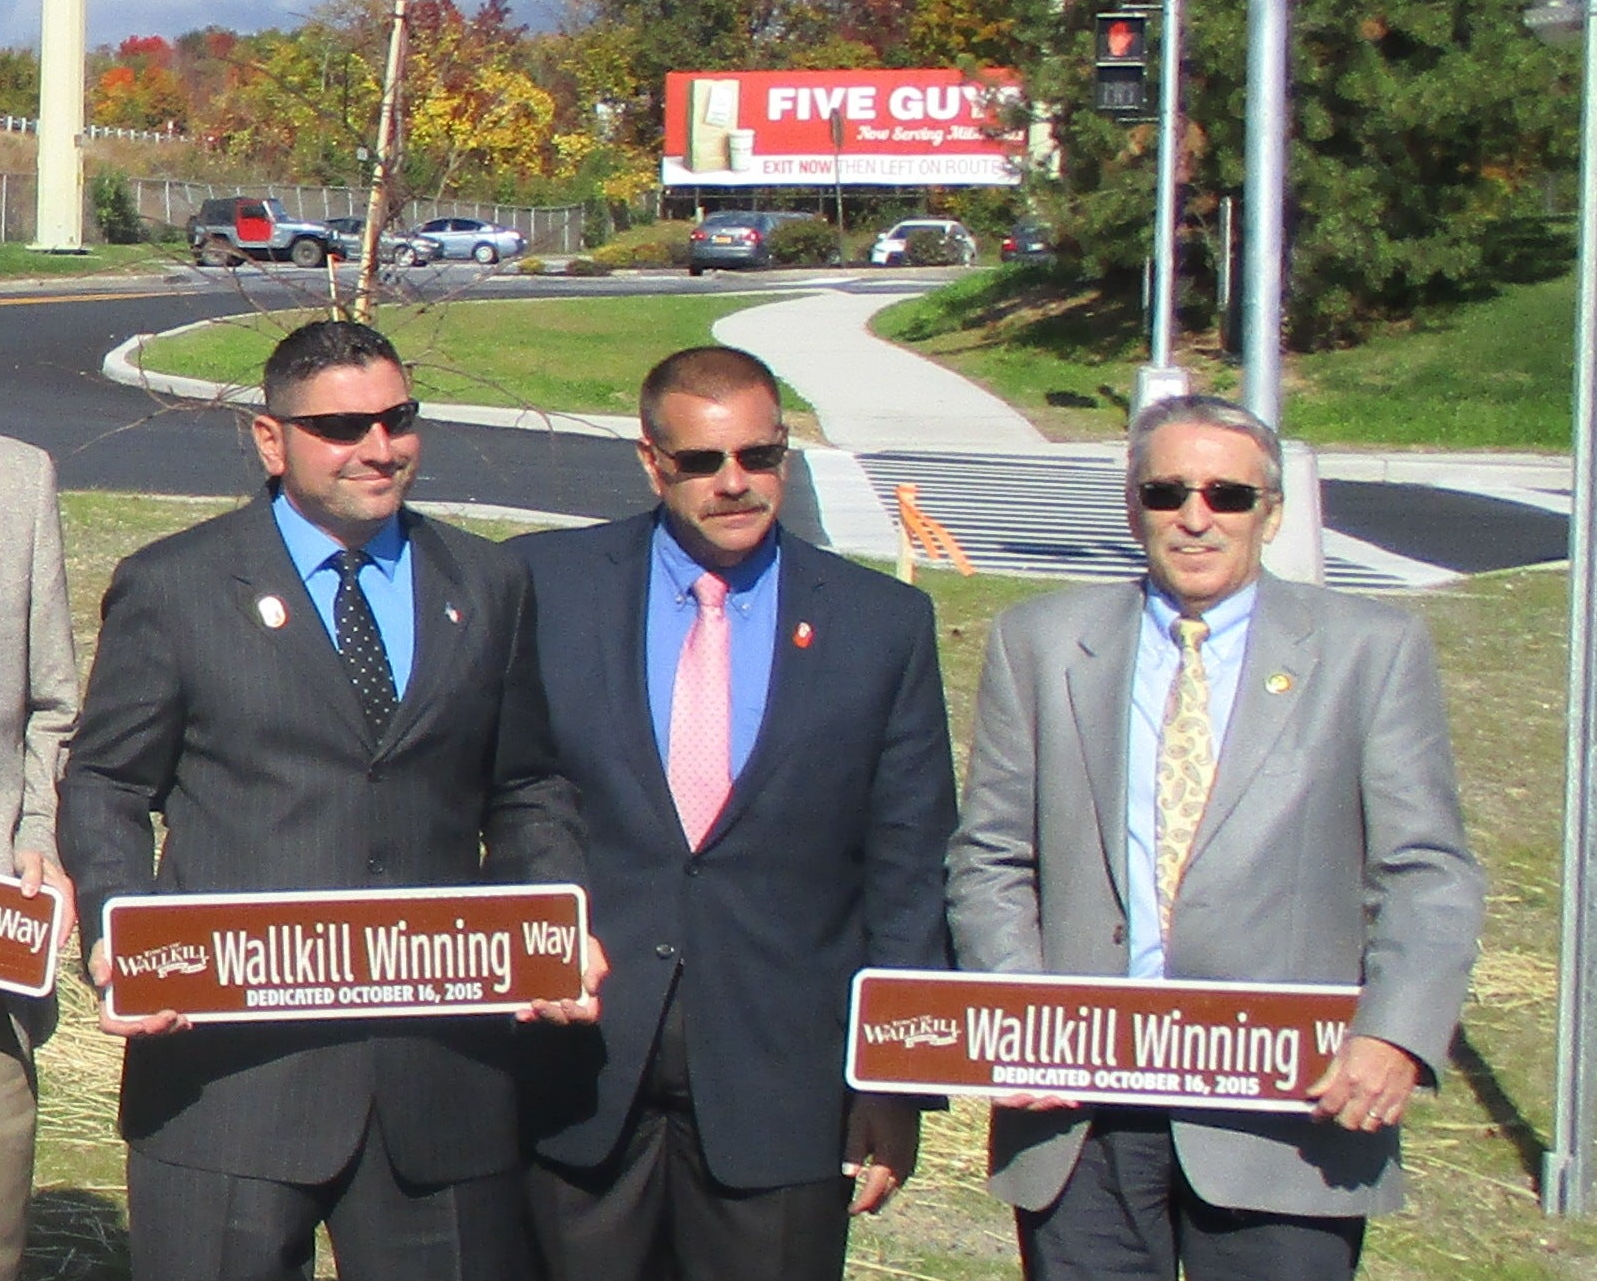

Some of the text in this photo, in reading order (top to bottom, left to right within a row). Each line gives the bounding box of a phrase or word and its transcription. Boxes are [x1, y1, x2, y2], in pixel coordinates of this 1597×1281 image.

[767, 86, 876, 120] FIVE
[857, 125, 889, 141] Now
[892, 126, 944, 147] Serving
[763, 159, 1000, 175] EXIT NOW THEN LEFT ON ROUTE
[213, 919, 575, 993] Wallkill Winning Way
[246, 982, 483, 1006] DEDICATED OCTOBER 16, 2015
[966, 1005, 1117, 1068] Wallkill
[1134, 1011, 1299, 1090] Winning
[992, 1065, 1260, 1096] DEDICATED OCTOBER 16, 2015
